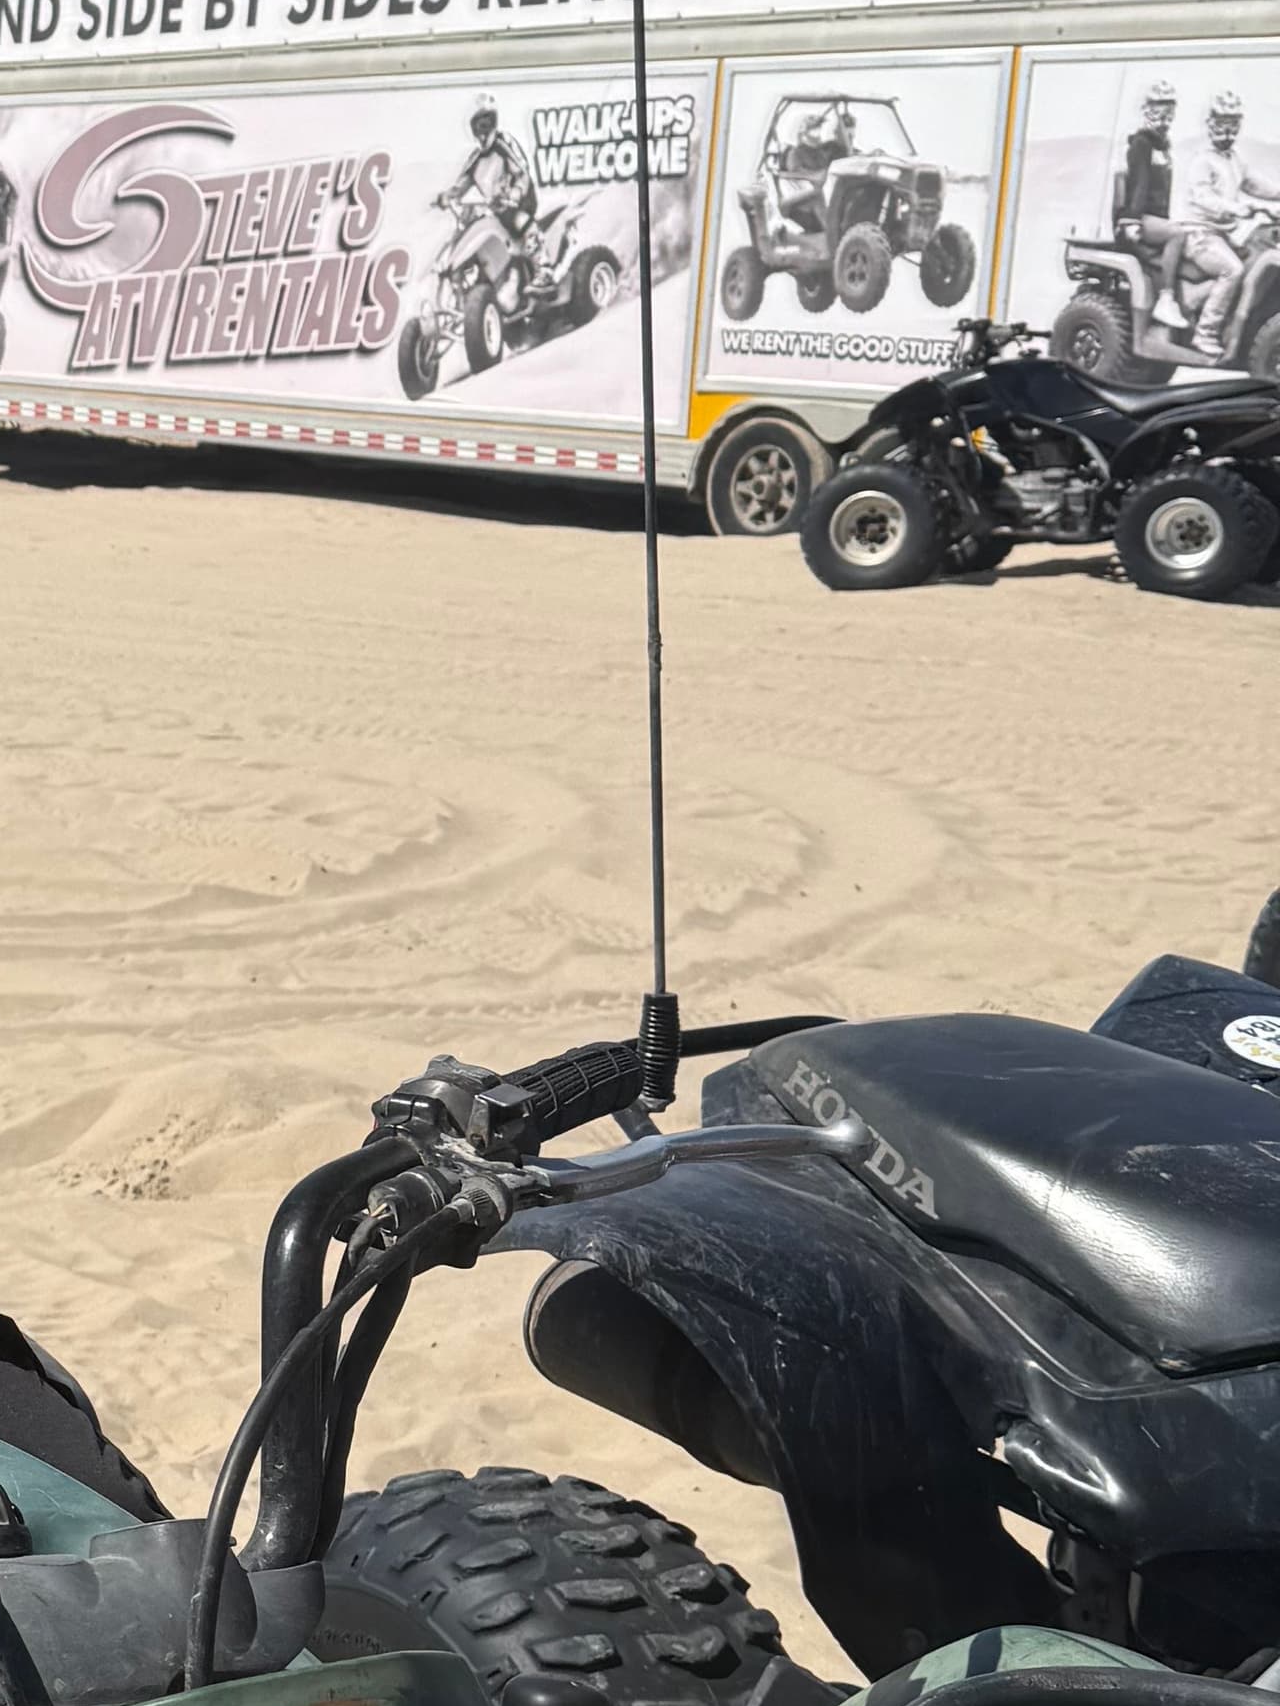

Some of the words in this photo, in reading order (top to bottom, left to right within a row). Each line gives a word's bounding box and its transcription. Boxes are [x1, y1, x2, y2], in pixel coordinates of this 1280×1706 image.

[533, 94, 695, 148] WALK-UPS
[535, 136, 690, 186] WELCOME
[70, 269, 184, 370] ATV
[167, 244, 411, 366] RENTALS
[721, 329, 751, 353] WE
[751, 330, 799, 356] RENT
[797, 332, 832, 358] THE
[832, 333, 895, 361] GOOD
